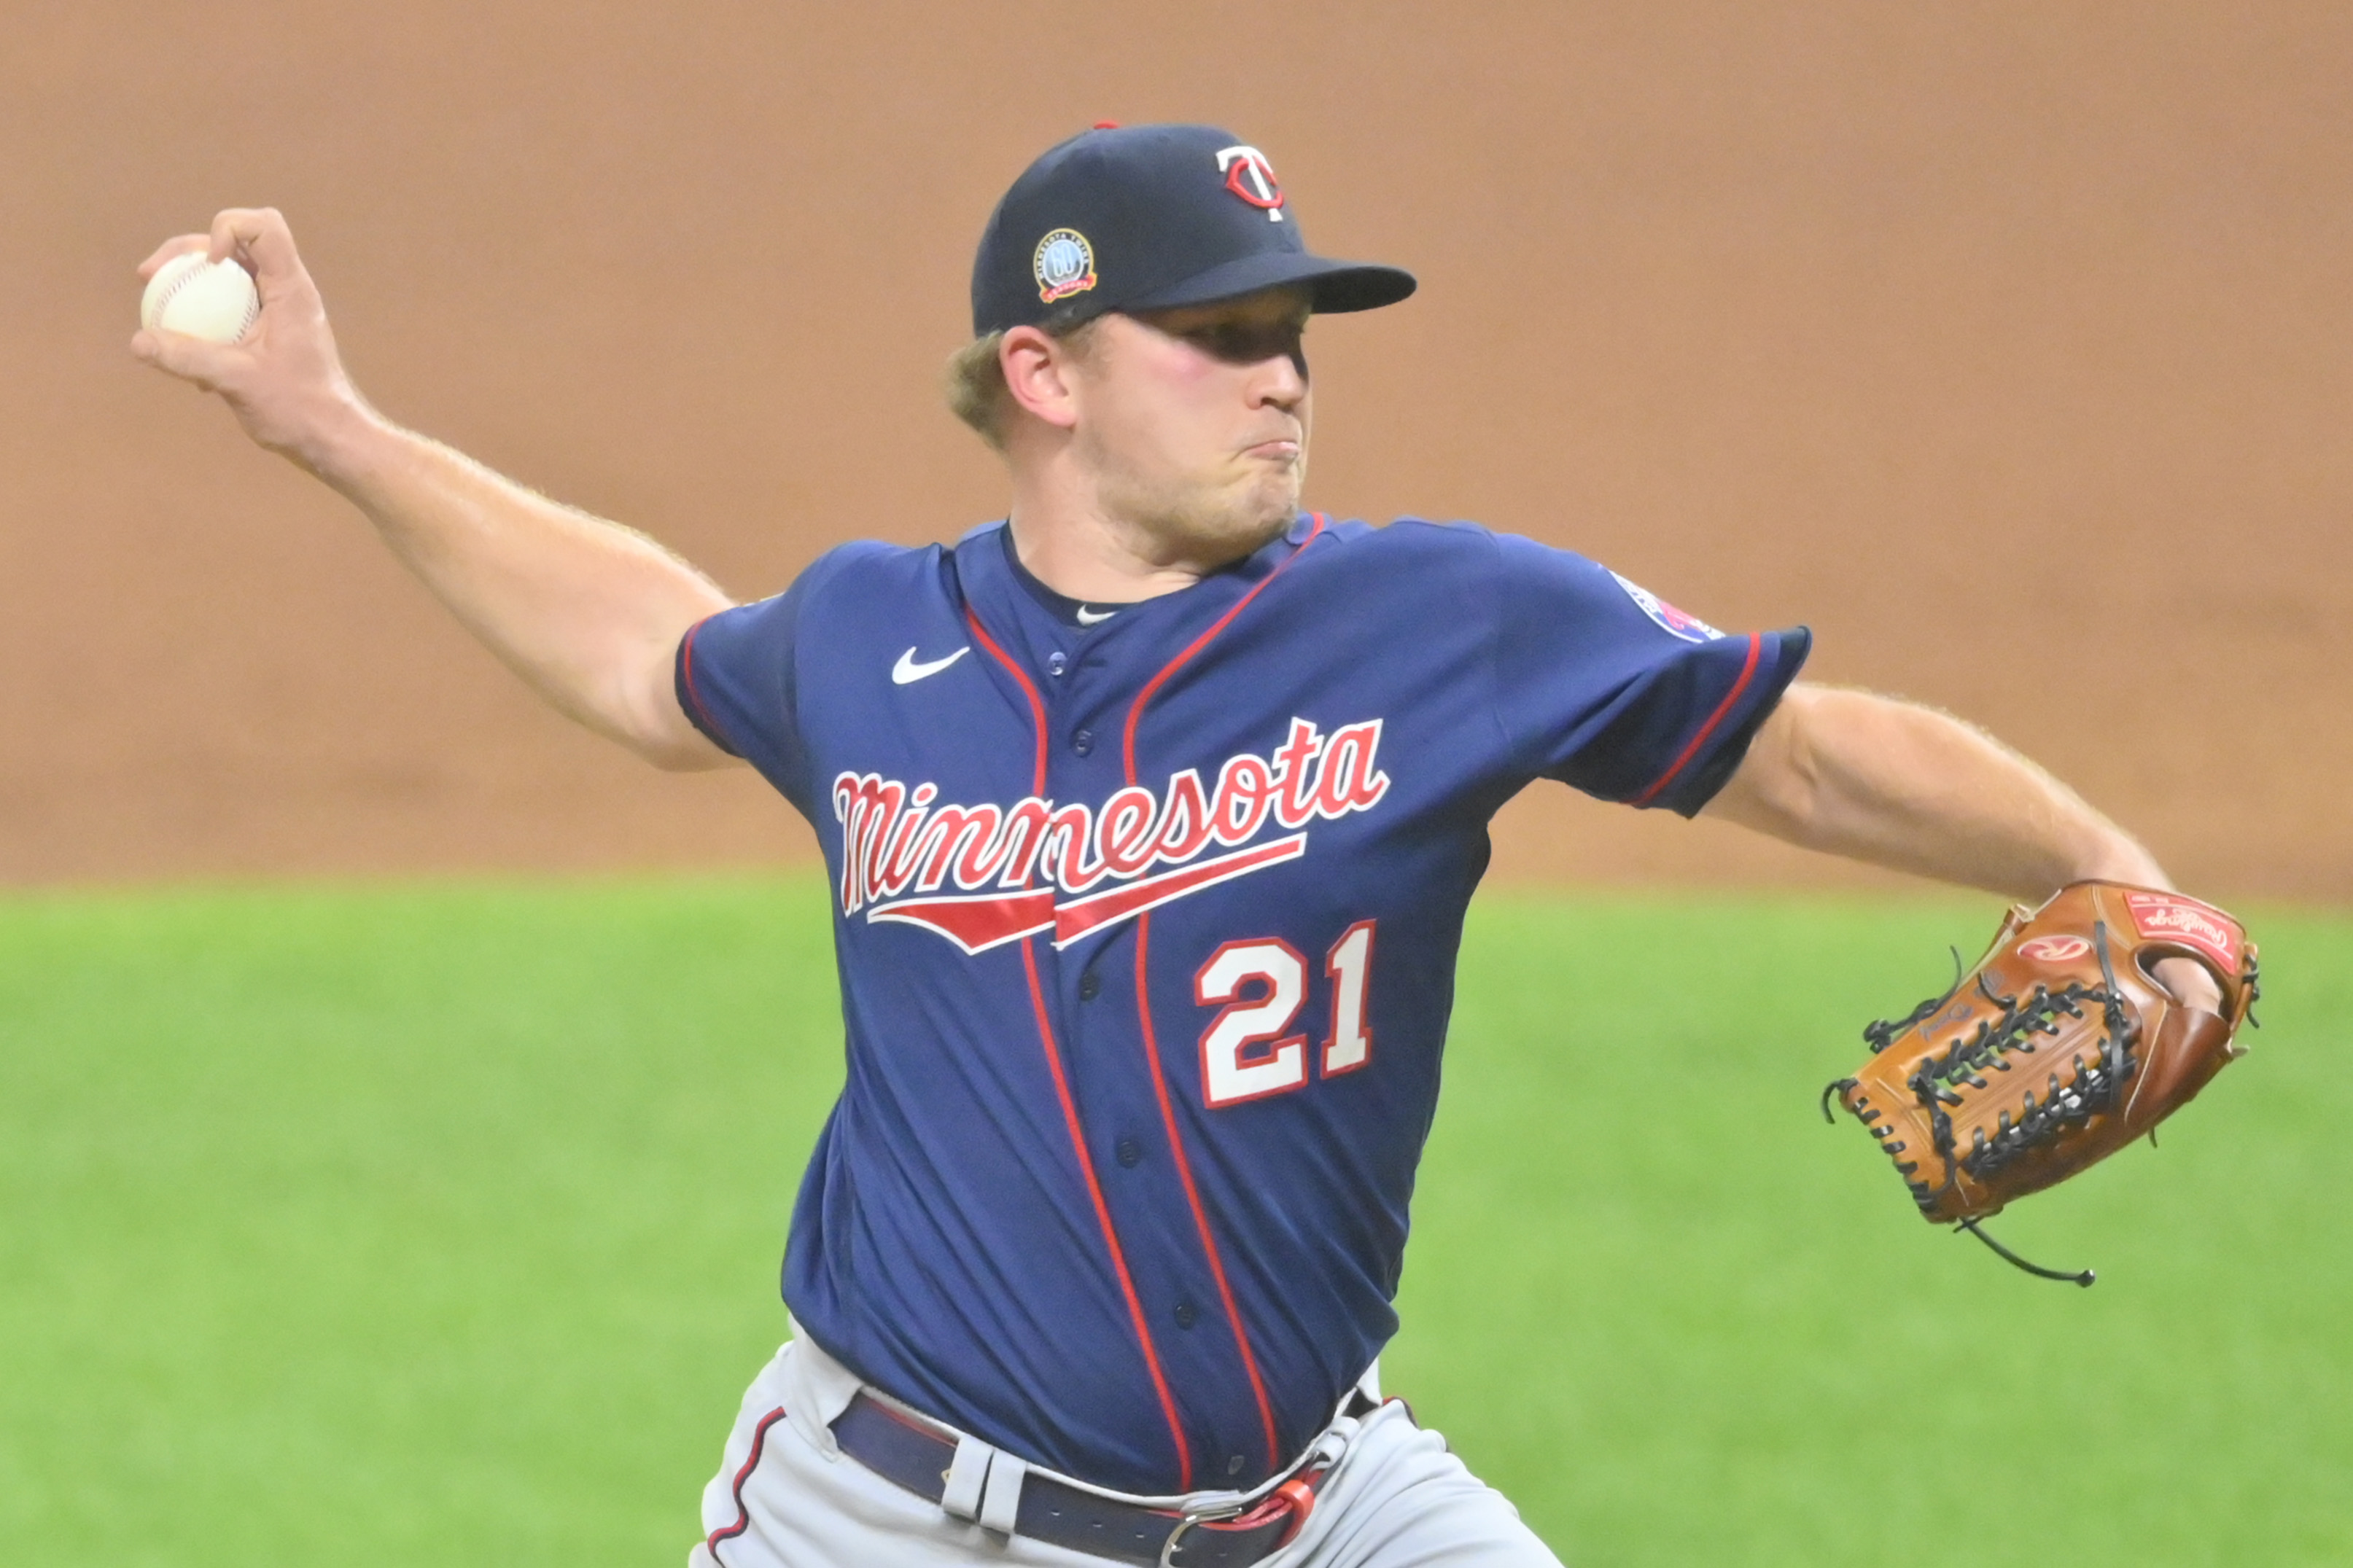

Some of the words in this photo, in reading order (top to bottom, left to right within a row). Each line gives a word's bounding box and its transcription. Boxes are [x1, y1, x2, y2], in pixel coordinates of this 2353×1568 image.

[833, 717, 1391, 918] Minnesota
[1194, 918, 1377, 1109] 21
[2144, 908, 2228, 950] Rawlings
